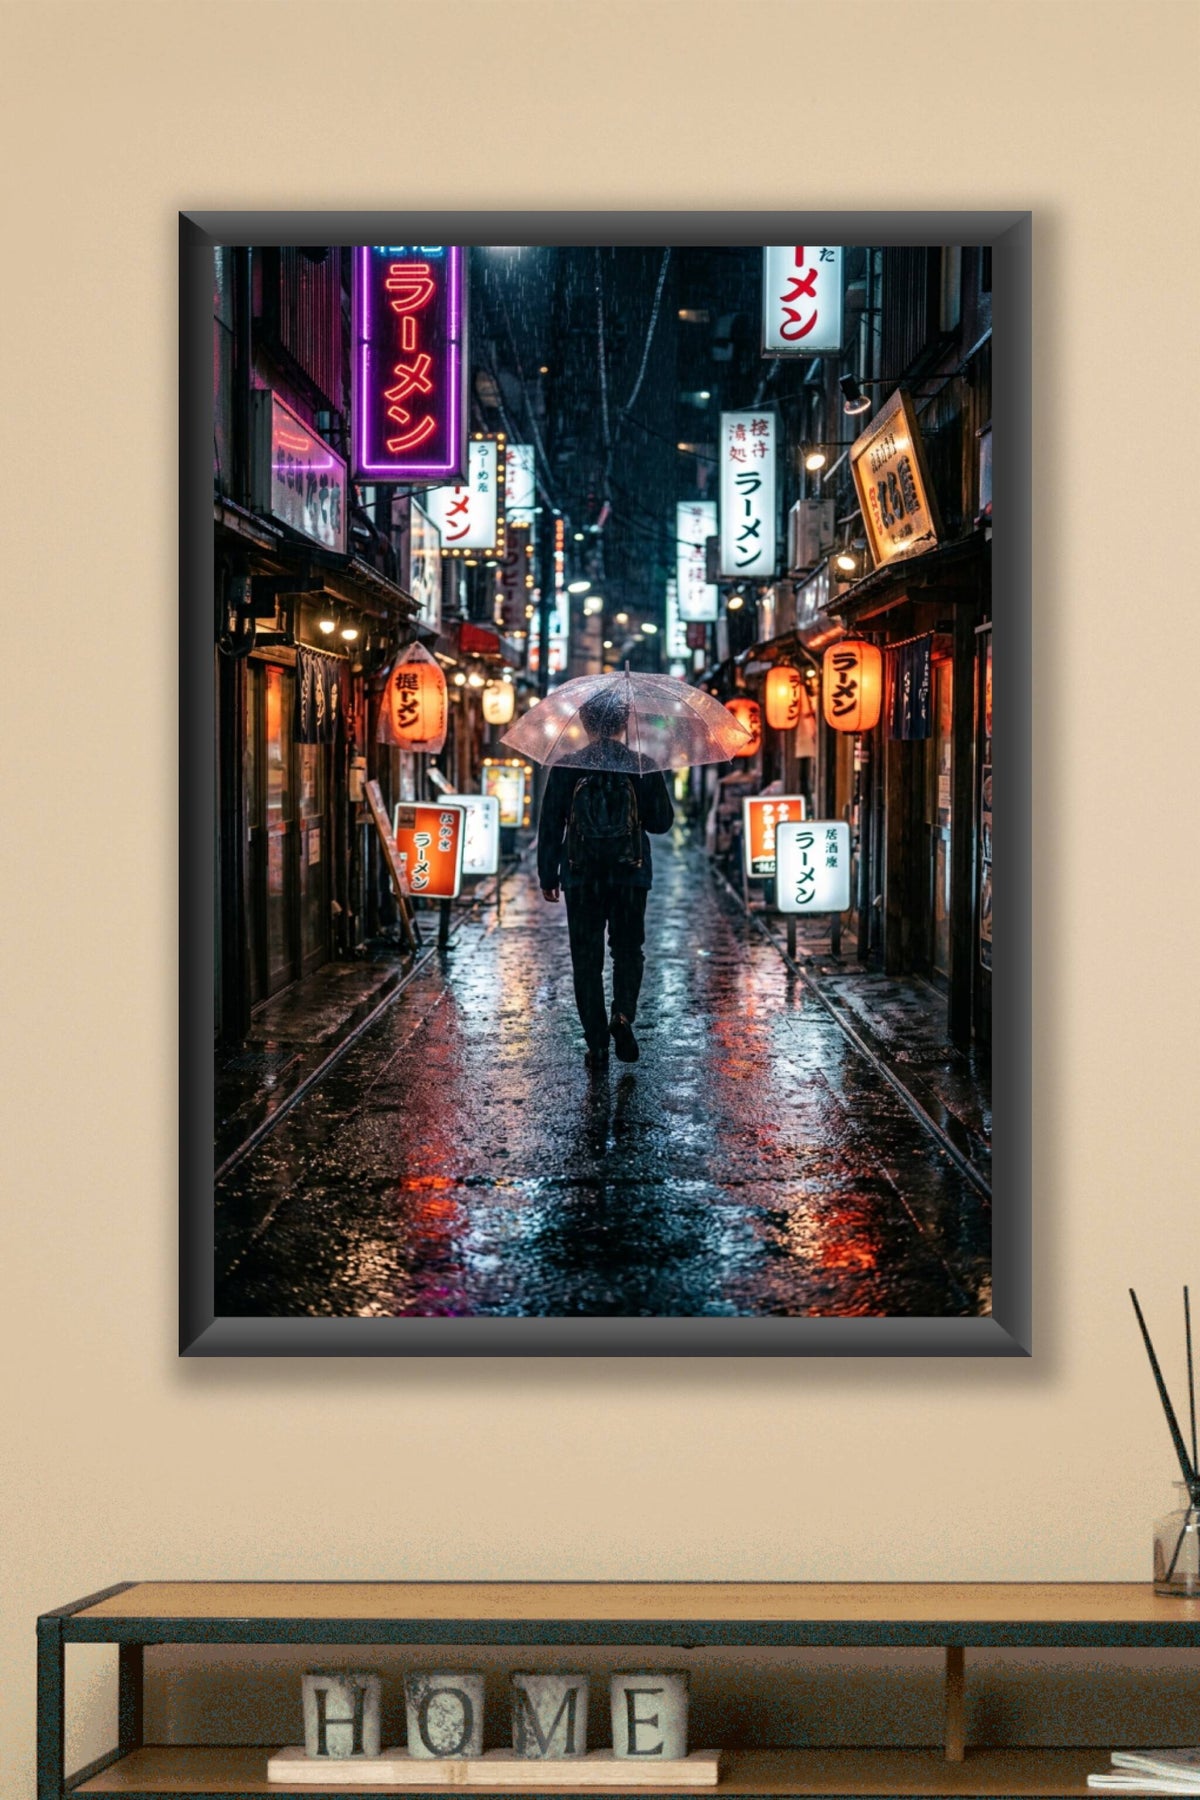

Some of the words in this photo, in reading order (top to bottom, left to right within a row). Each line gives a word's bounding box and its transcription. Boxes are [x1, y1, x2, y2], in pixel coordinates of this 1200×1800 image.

[385, 263, 435, 453] ラーメン
[734, 471, 762, 569] ラーメン
[832, 651, 859, 718] ラーメン
[411, 832, 431, 890] ラーメン
[795, 831, 816, 905] ラーメン
[315, 1687, 665, 1757] HOME
